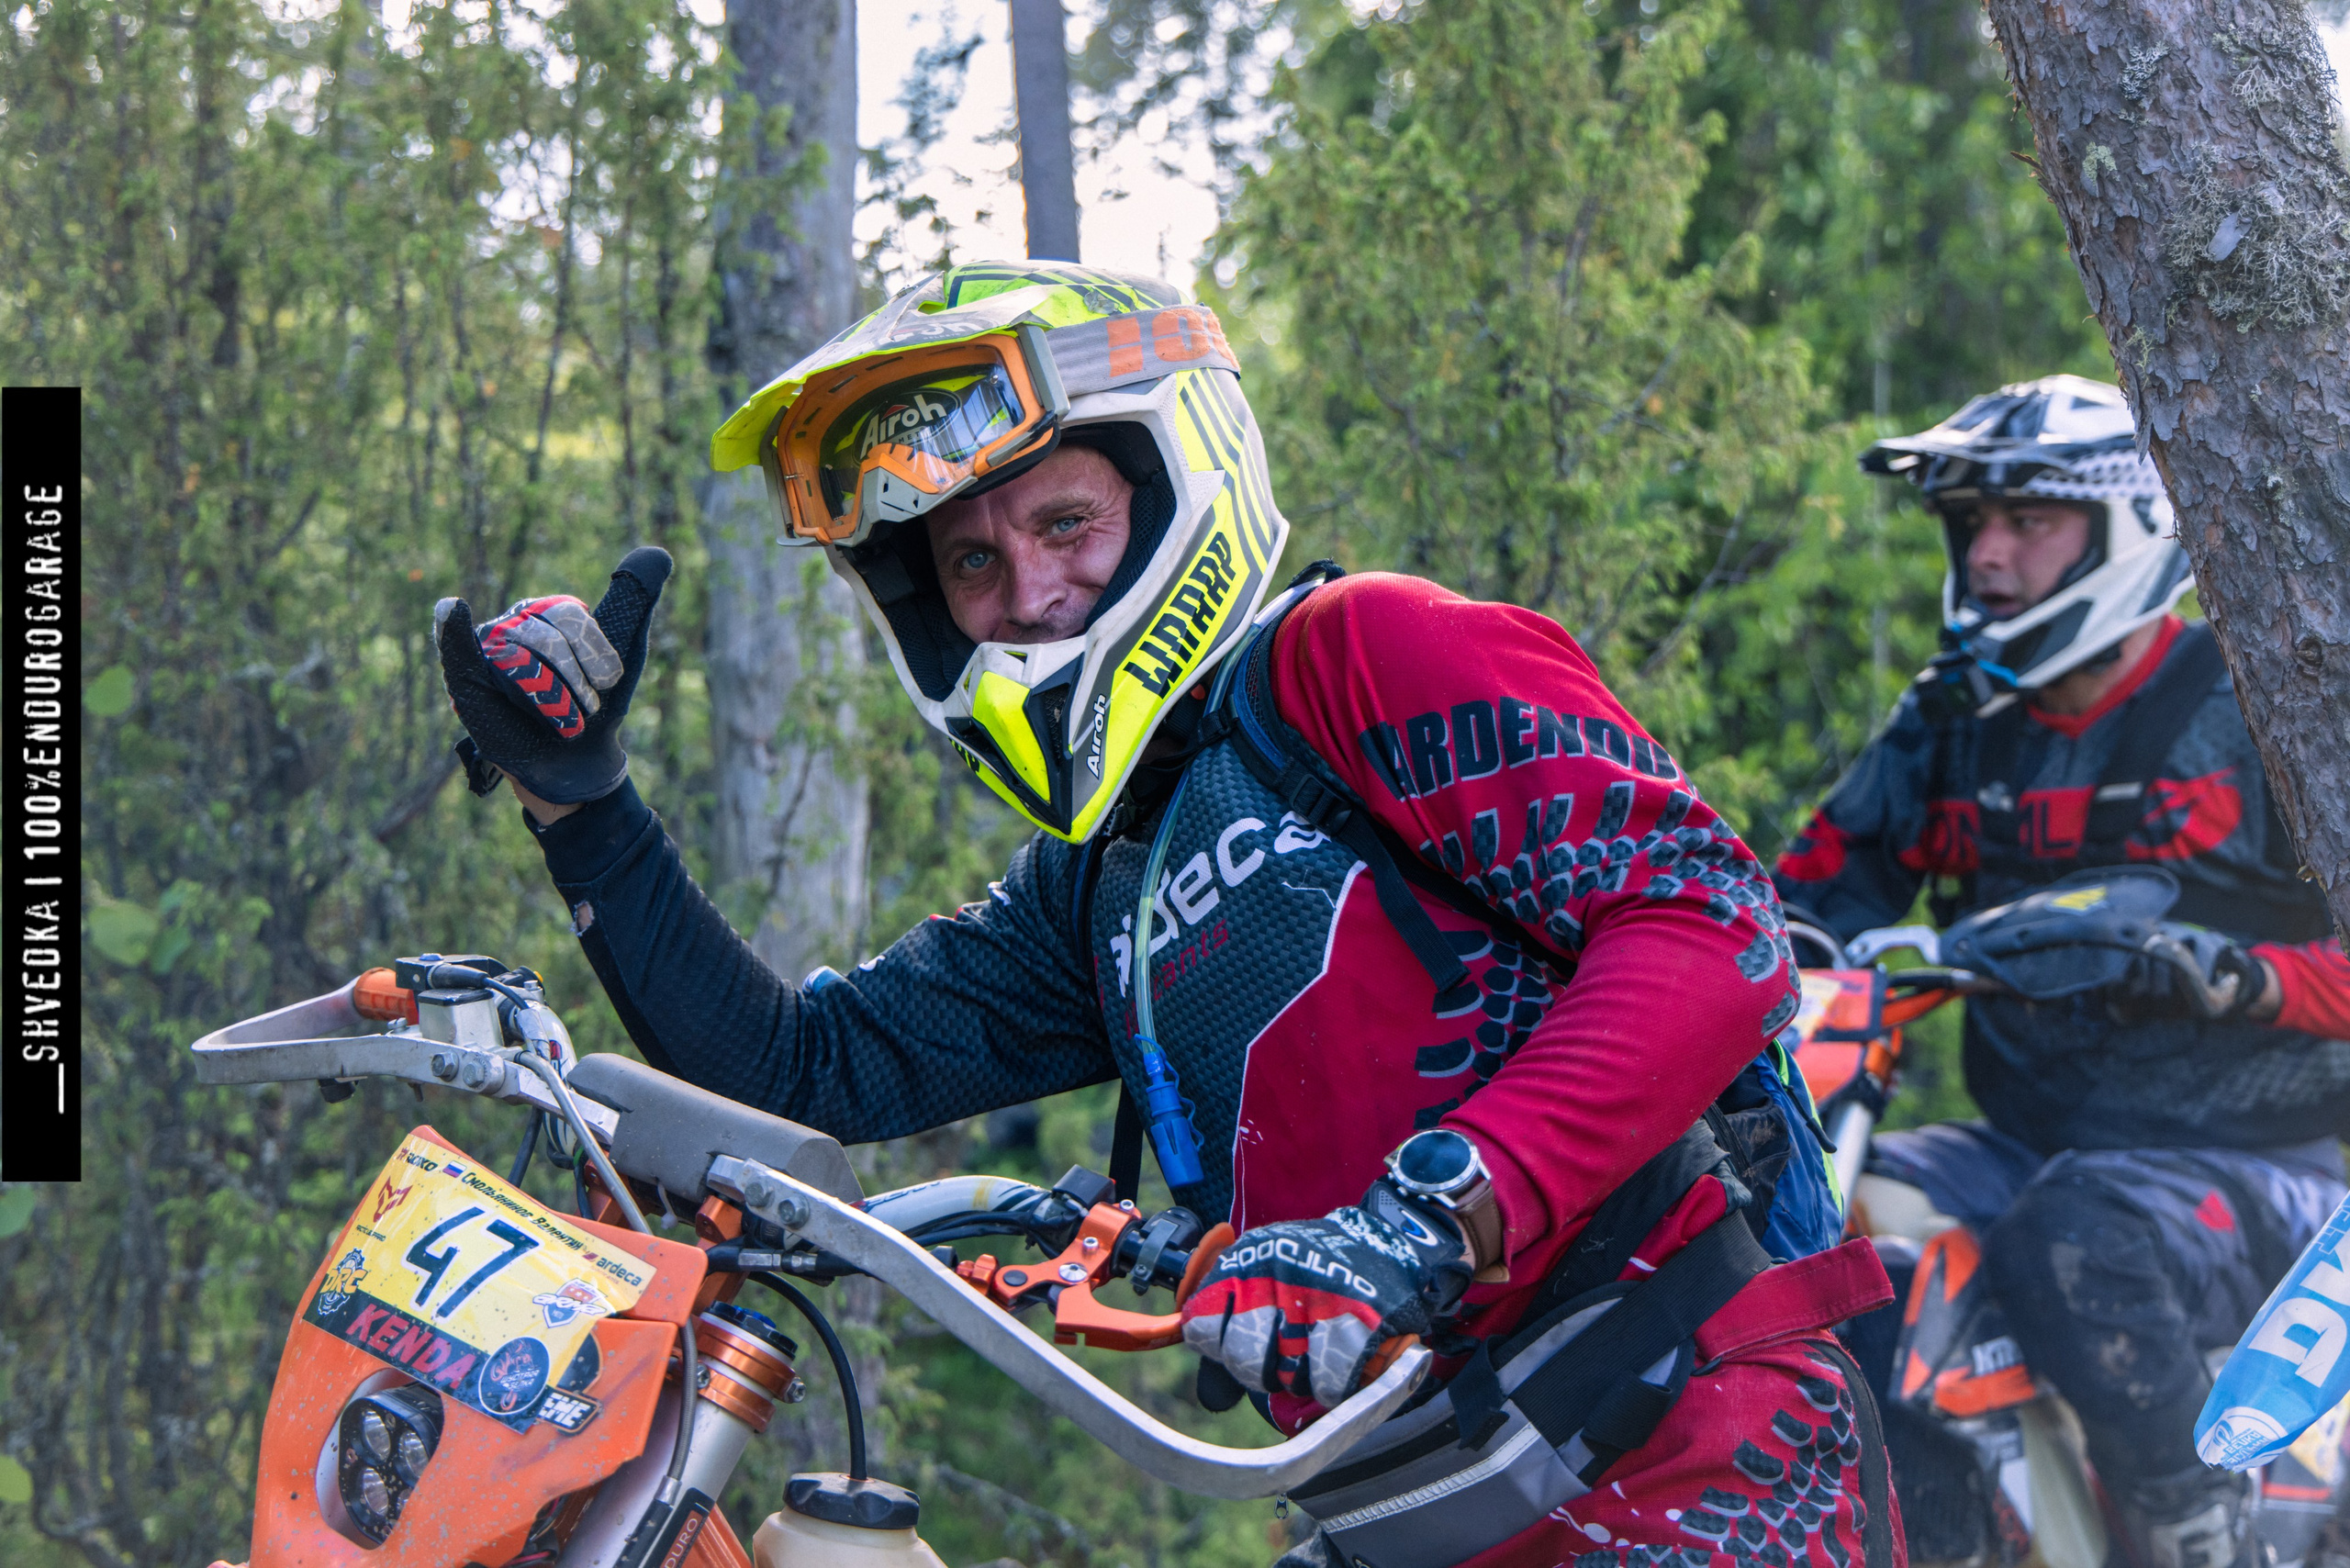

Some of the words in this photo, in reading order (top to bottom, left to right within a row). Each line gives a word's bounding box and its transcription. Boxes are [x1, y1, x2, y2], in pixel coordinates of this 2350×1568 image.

[860, 394, 946, 459] Airoh
[1086, 694, 1106, 779] Airoh
[1358, 696, 1698, 802] ARDENDU
[319, 1268, 368, 1294] DRC
[406, 1206, 540, 1318] 47
[596, 1256, 643, 1287] ardeca
[1219, 1238, 1377, 1298] OUTDOOR
[345, 1304, 477, 1389] KENDA
